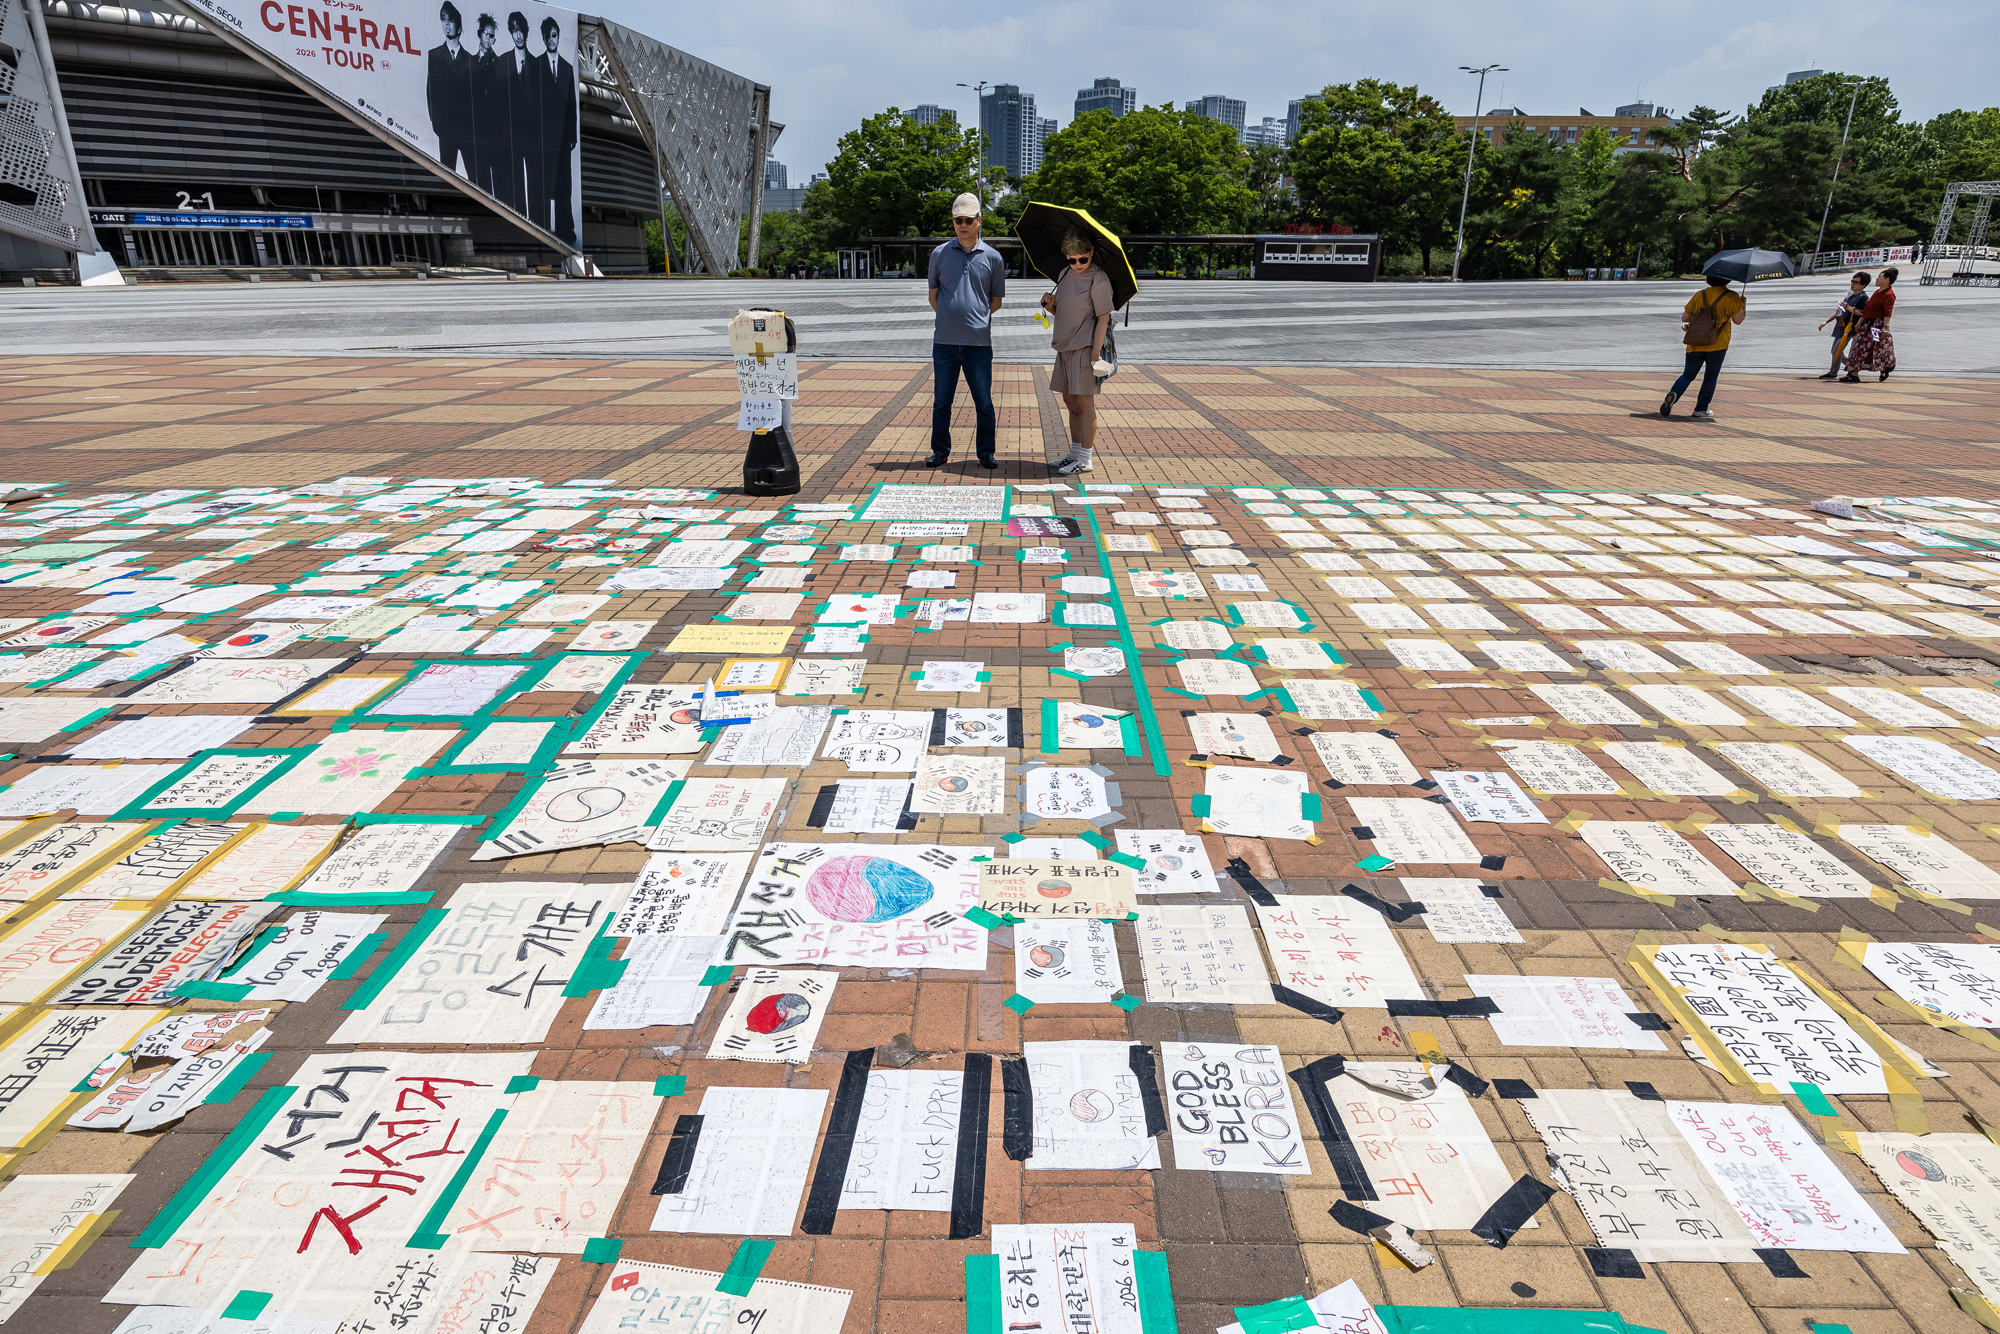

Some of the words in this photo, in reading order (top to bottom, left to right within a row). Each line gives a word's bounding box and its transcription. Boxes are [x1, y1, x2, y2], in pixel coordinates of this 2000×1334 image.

[216, 6, 244, 29] SEOUL
[296, 48, 316, 58] 2026
[322, 47, 375, 72] TOUR
[366, 104, 383, 117] MPMG
[394, 123, 405, 132] THE
[404, 128, 419, 141] VAULT
[102, 214, 126, 222] GATE
[175, 191, 215, 210] 2-1
[1286, 223, 1324, 234] Ticket
[1330, 223, 1355, 234] Box
[621, 713, 657, 744] 당일투표
[639, 688, 674, 712] 수개표
[714, 731, 744, 763] A-WEB
[657, 805, 699, 848] 부정선거
[829, 785, 864, 827] 타도북괴
[116, 822, 206, 868] KOREAN
[387, 839, 419, 862] 다문화
[424, 831, 448, 850] 하자
[752, 822, 764, 839] HATE
[182, 870, 241, 897] LAST
[222, 829, 287, 865] CHANCE
[250, 858, 305, 882] SAVE
[315, 854, 352, 881] 다문화
[338, 872, 363, 888] 으로
[985, 863, 1040, 876] 수개표
[989, 878, 1026, 886] STEAL
[1049, 864, 1120, 878] 당일투표
[1606, 851, 1656, 881] 생명의
[1663, 858, 1702, 885] 자유의
[1736, 853, 1783, 888] 사랑하는
[228, 884, 274, 898] TO
[724, 857, 807, 961] 재선거
[981, 899, 1042, 914] 재선거
[1051, 900, 1131, 916] 부정선거
[632, 905, 663, 934] 국민주권
[657, 911, 681, 933] 참정권
[669, 893, 690, 910] 박탈
[1418, 901, 1447, 931] MAKE
[1443, 903, 1474, 933] KOREA
[1461, 905, 1492, 936] GREAT
[94, 976, 142, 1001] NO
[129, 903, 218, 973] DEMOCRACY
[125, 966, 178, 1001] FRAUD
[171, 905, 247, 963] ELECTION
[302, 934, 355, 979] Again!
[381, 896, 533, 1024] 당일투표
[486, 899, 602, 1010] 수개표
[1088, 946, 1109, 975] 어게인
[1151, 937, 1164, 954] 시대
[1269, 909, 1319, 989] 한미공조
[1690, 952, 1734, 981] 아닌
[59, 978, 106, 1002] NO
[244, 951, 307, 987] Yoon
[1735, 951, 1816, 1011] 목소리다
[1883, 951, 1949, 996] 자유는
[1718, 985, 1781, 1024] 입김이
[1711, 1025, 1779, 1078] 나라의
[1763, 1031, 1833, 1085] 정치인의
[1794, 1018, 1880, 1076] 국민의
[148, 1057, 224, 1112] 이재명
[922, 1072, 961, 1131] DPRK
[1113, 1073, 1144, 1138] 재선거
[1172, 1069, 1212, 1136] GOD
[1202, 1060, 1249, 1145] BLESS
[1033, 1062, 1070, 1153] 부정선거
[1234, 1047, 1303, 1168] KOREA
[844, 1131, 879, 1196] Fuck
[863, 1073, 902, 1122] CCP
[1402, 1101, 1459, 1165] 탄핵
[1685, 1111, 1727, 1154] out
[1720, 1117, 1757, 1157] out
[296, 1077, 494, 1256] 재선거
[534, 1092, 641, 1239] 공산주의
[911, 1134, 951, 1195] Fuck
[1546, 1124, 1648, 1241] 부정선거
[1618, 1126, 1724, 1241] 원천무효
[50, 1182, 114, 1237] 속지말자
[1924, 1203, 1974, 1254] 음서제도
[500, 1254, 543, 1301] 수개표
[1058, 1244, 1093, 1334] 대한민국
[618, 1286, 734, 1334] 알고리즘
